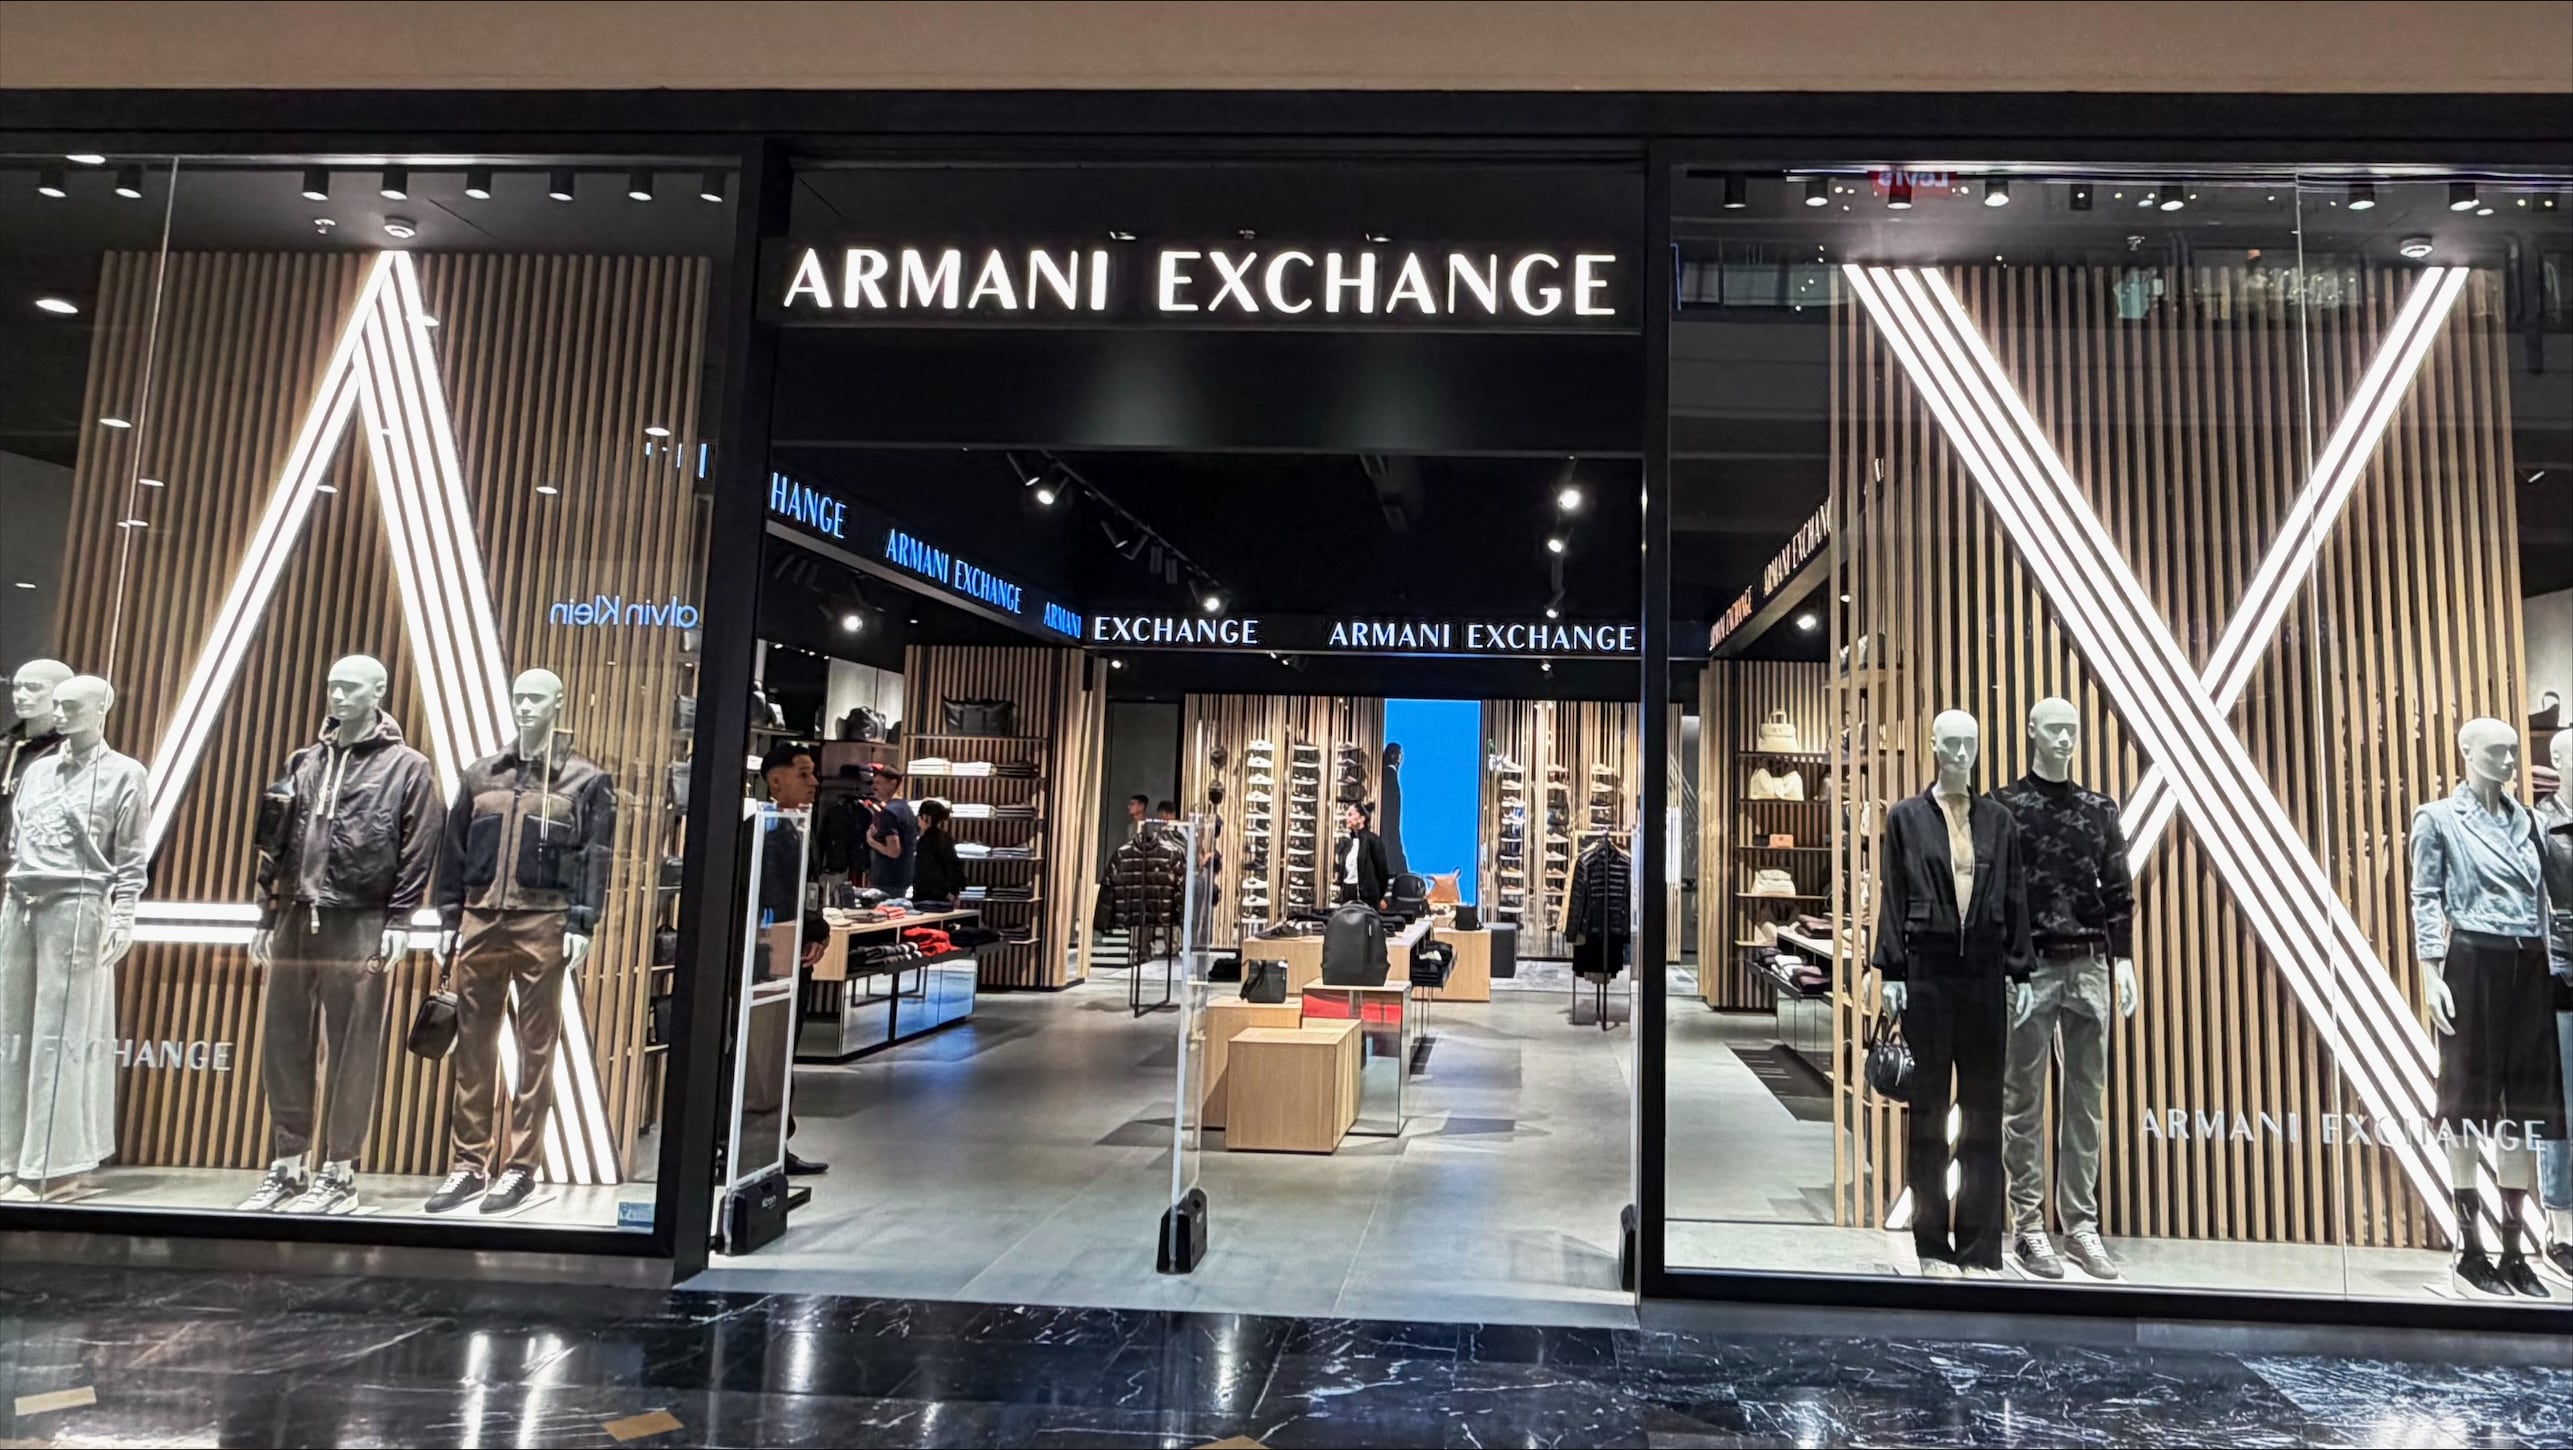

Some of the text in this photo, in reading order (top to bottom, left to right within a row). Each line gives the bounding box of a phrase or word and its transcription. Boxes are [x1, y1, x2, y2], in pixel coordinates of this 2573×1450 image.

[783, 247, 1616, 317] ARMANI EXCHANGE
[885, 528, 1024, 615] ARMANI EXCHANGE
[1093, 616, 1260, 645] EXCHANGE
[1328, 621, 1637, 651] ARMANI EXCHANGE
[2140, 1107, 2547, 1152] ARMANI EXCHANGE
